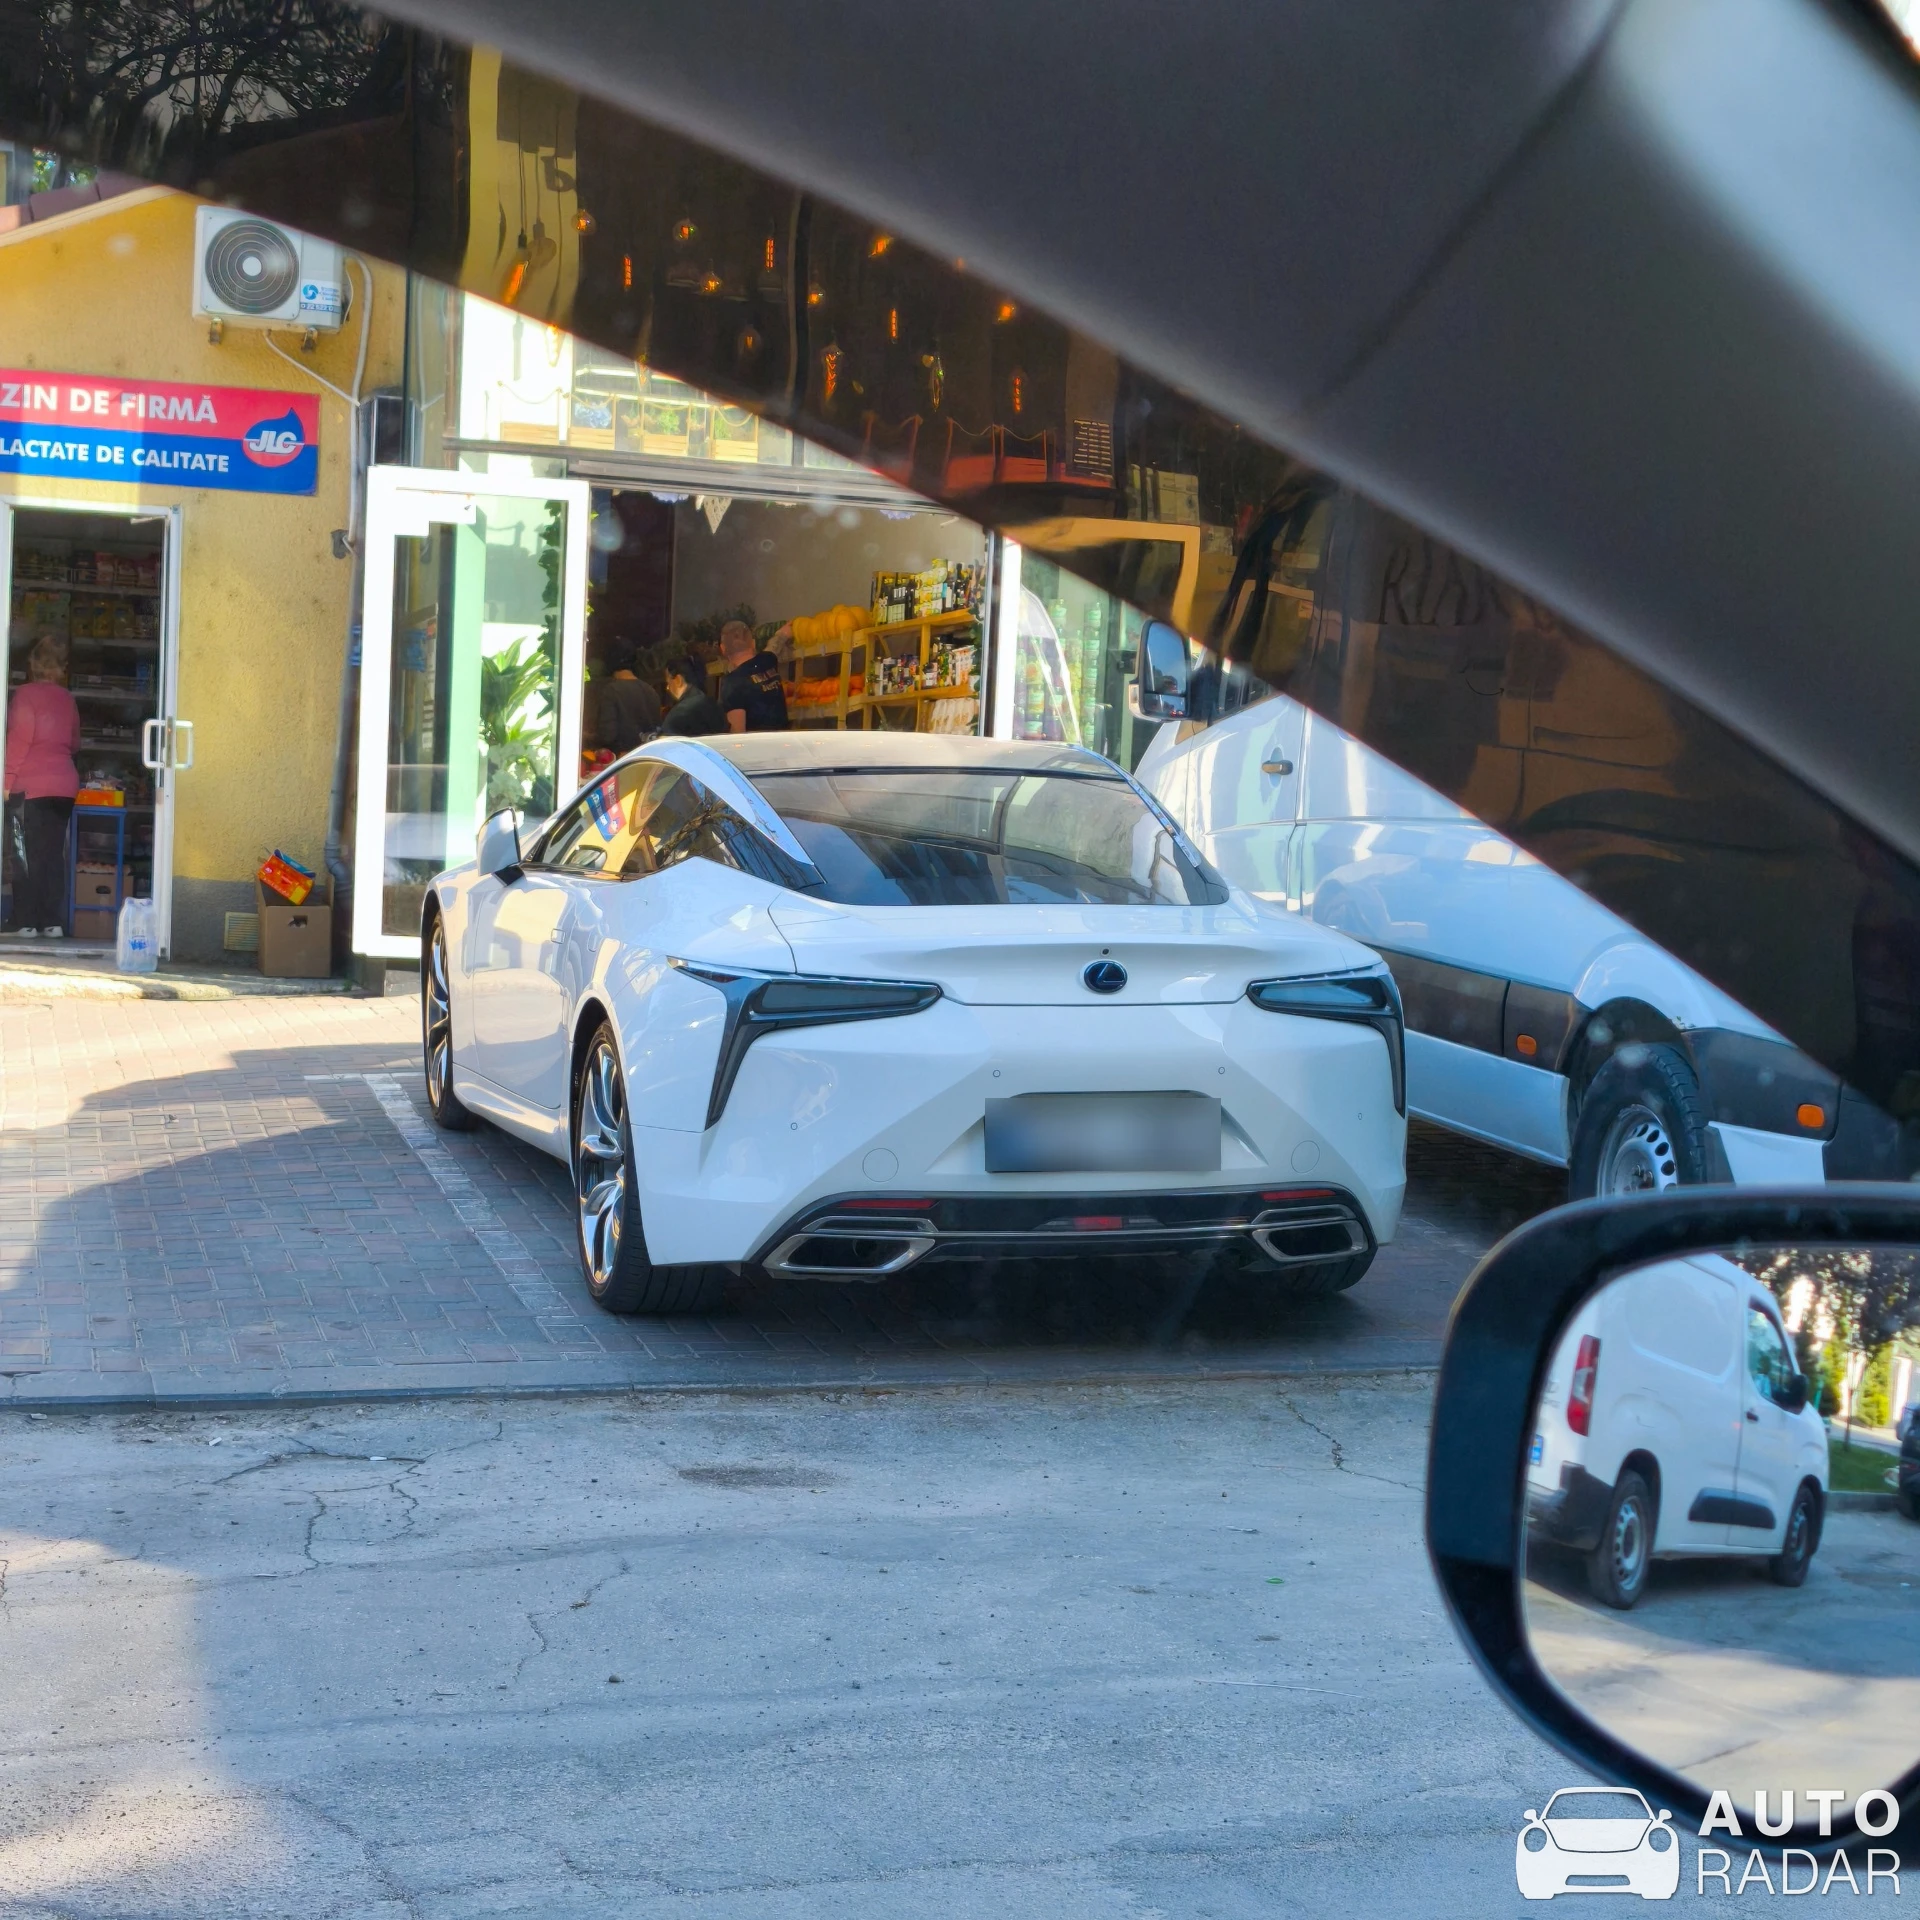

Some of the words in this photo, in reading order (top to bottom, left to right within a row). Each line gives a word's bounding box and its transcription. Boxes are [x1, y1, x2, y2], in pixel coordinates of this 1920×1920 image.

[0, 382, 58, 411] ZIN
[69, 388, 109, 416] DE
[120, 392, 218, 424] FIRMĂ
[0, 437, 90, 462] LACTATE
[96, 445, 125, 465] DE
[131, 448, 230, 473] CALITATE
[249, 430, 297, 453] JLC
